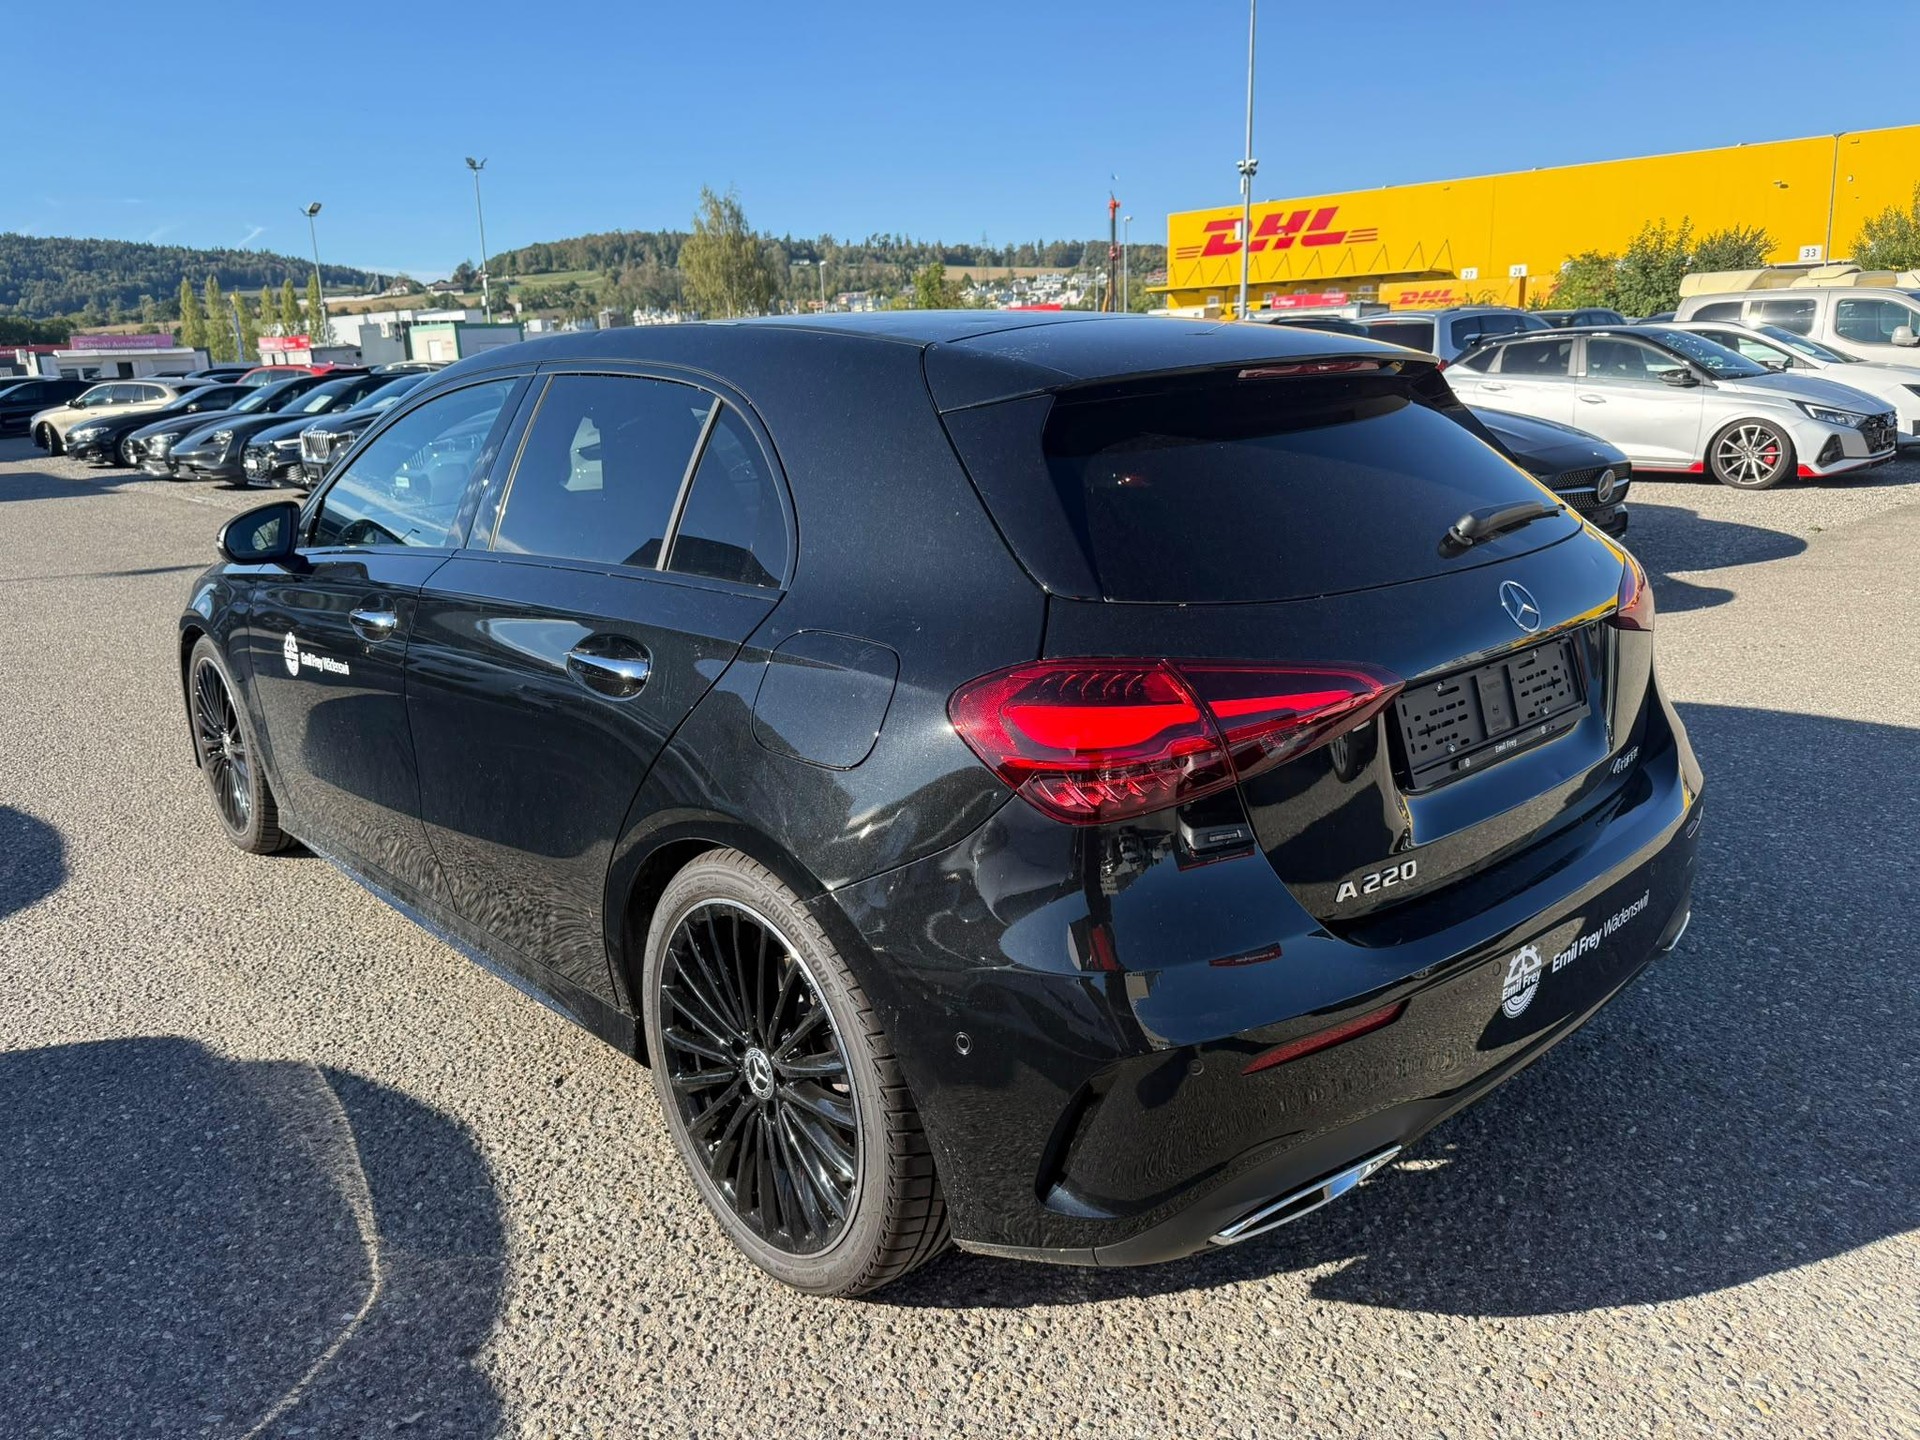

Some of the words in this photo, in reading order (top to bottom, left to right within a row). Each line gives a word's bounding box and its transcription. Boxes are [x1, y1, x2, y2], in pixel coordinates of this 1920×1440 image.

[1201, 206, 1348, 257] DHL
[1804, 248, 1816, 257] 33
[1399, 289, 1453, 305] DHL
[1335, 881, 1358, 902] A
[1363, 860, 1417, 894] 220
[1551, 941, 1579, 973] Emil
[1579, 928, 1602, 952] Frey
[1603, 889, 1650, 938] Wädenswil
[1502, 979, 1522, 1001] Emil
[1522, 969, 1541, 989] Frey
